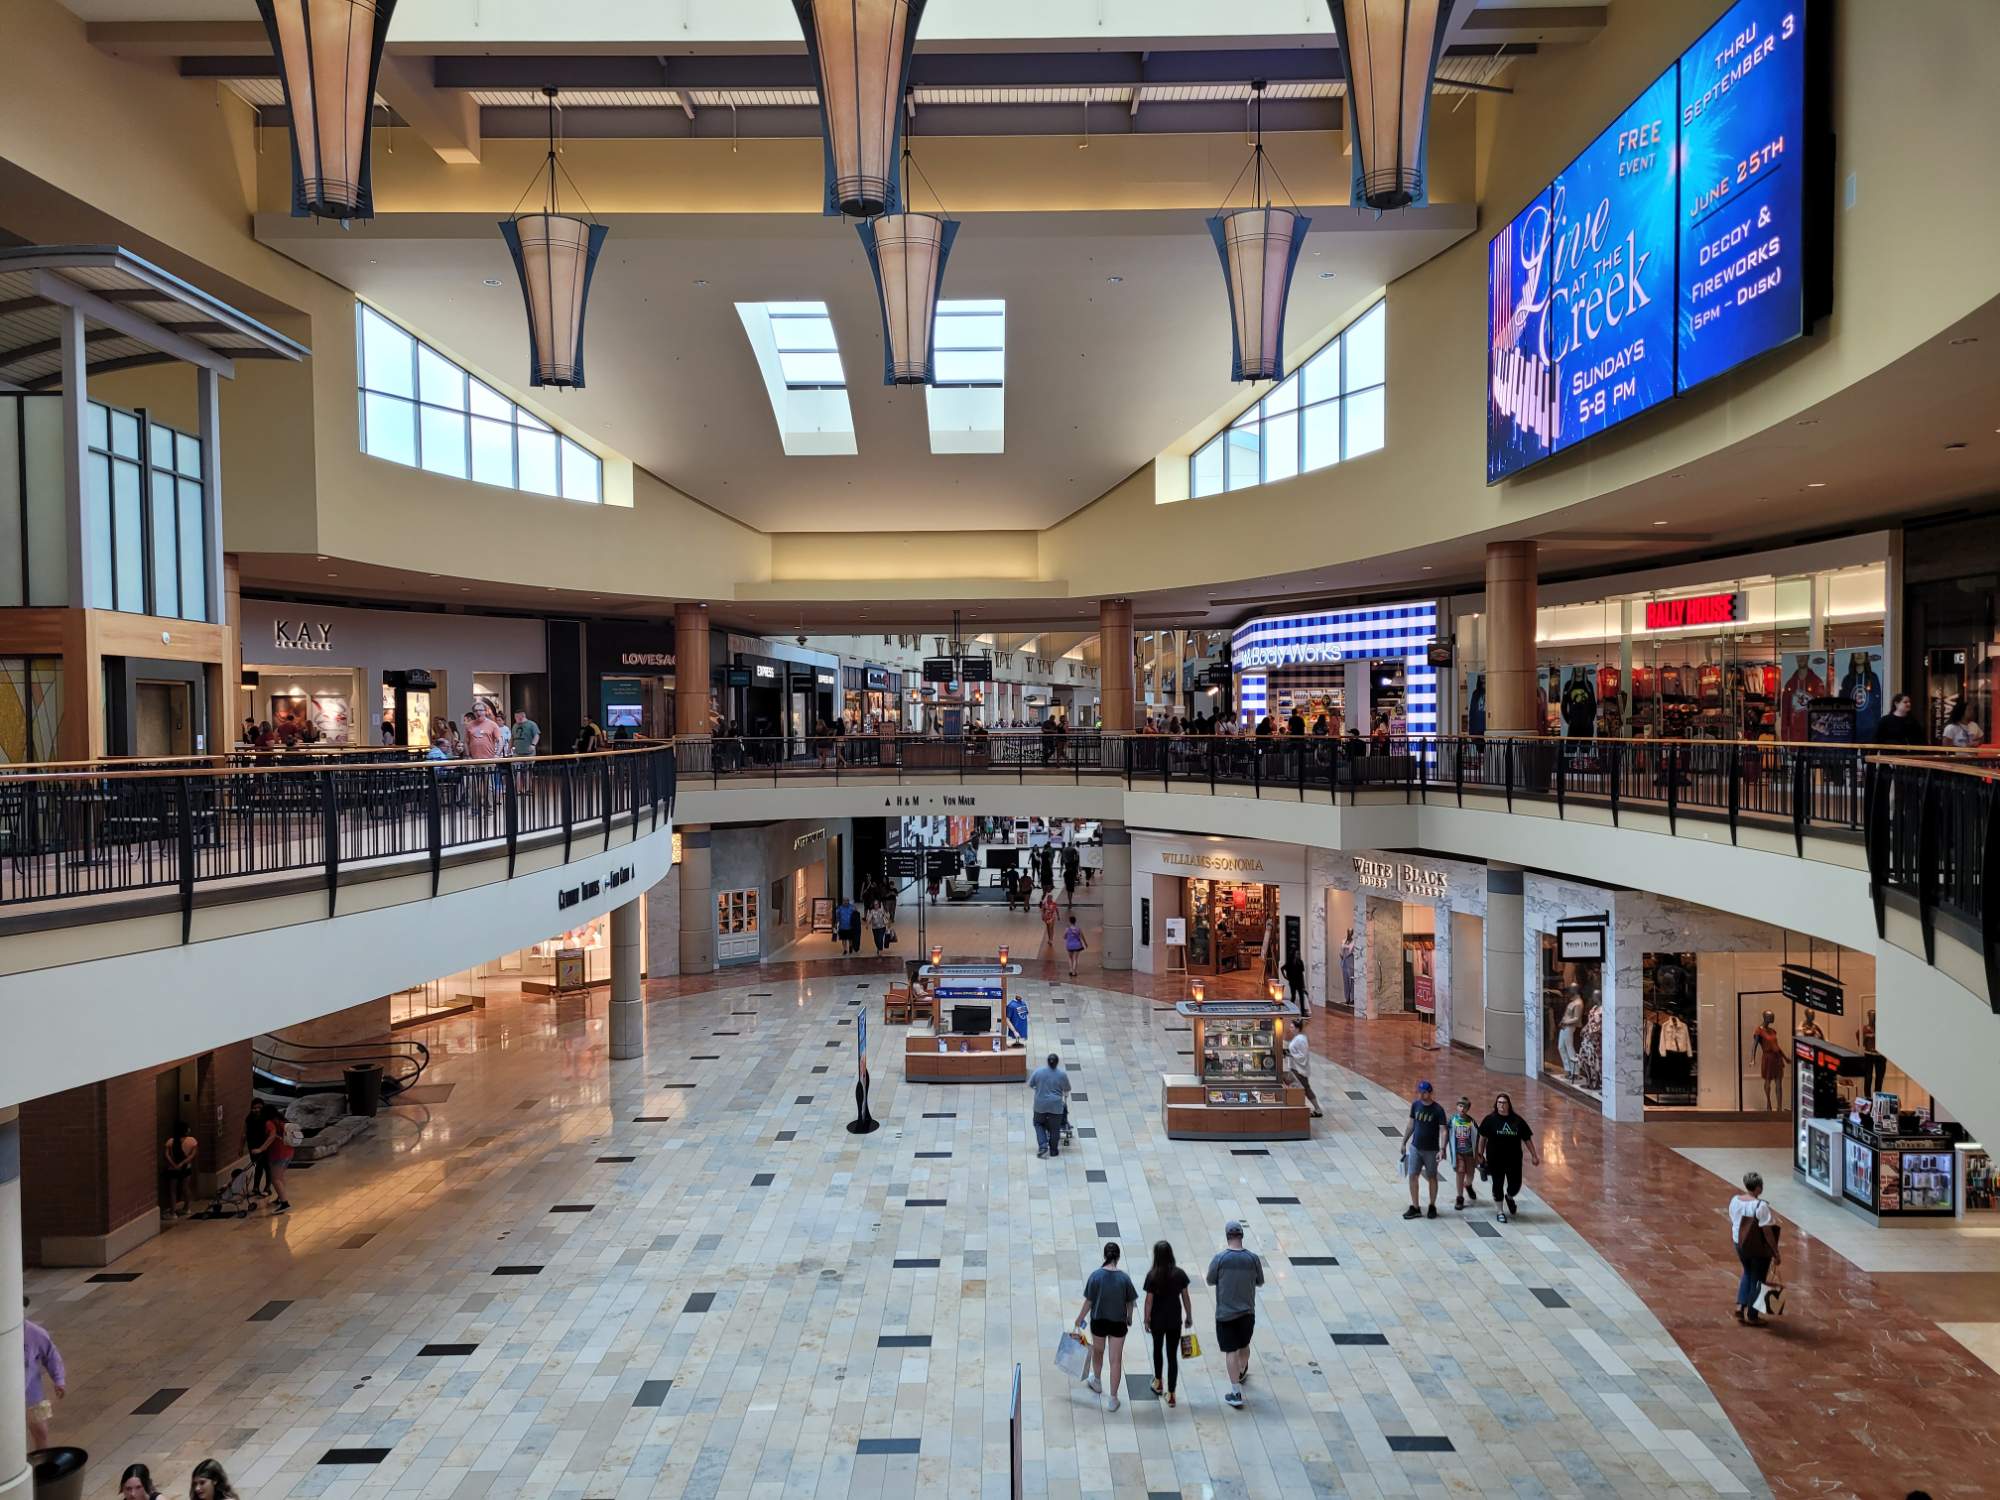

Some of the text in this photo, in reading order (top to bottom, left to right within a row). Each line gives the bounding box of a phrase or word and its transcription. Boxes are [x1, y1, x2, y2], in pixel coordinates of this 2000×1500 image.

[1715, 21, 1757, 70] THRU
[1683, 14, 1795, 127] SEPTEMBER 3
[1618, 120, 1662, 155] FREE
[1618, 153, 1656, 177] EVENT
[1690, 136, 1785, 217] JUNE 25TH
[1516, 185, 1610, 327] Live
[1699, 205, 1771, 267] DECOY &
[1572, 245, 1622, 294] AT THE
[1691, 236, 1781, 304] FIREWORKS
[1539, 229, 1652, 366] Creek
[1689, 303, 1721, 332] (5PM
[1737, 267, 1782, 306] DUSK)
[1573, 338, 1644, 395] SUNDAYS
[1579, 376, 1636, 423] 5-8 PM
[274, 620, 333, 642] KAY
[1647, 593, 1733, 629] RALLY HOUSE
[756, 664, 775, 678] EXPRESS
[1287, 642, 1342, 663] Works
[1944, 692, 1960, 725] VAN
[896, 795, 902, 806] H
[904, 797, 910, 806] &
[912, 795, 919, 806] M
[1352, 857, 1448, 887] WHITE BLACK
[1359, 874, 1446, 897] HOUSE MARKET
